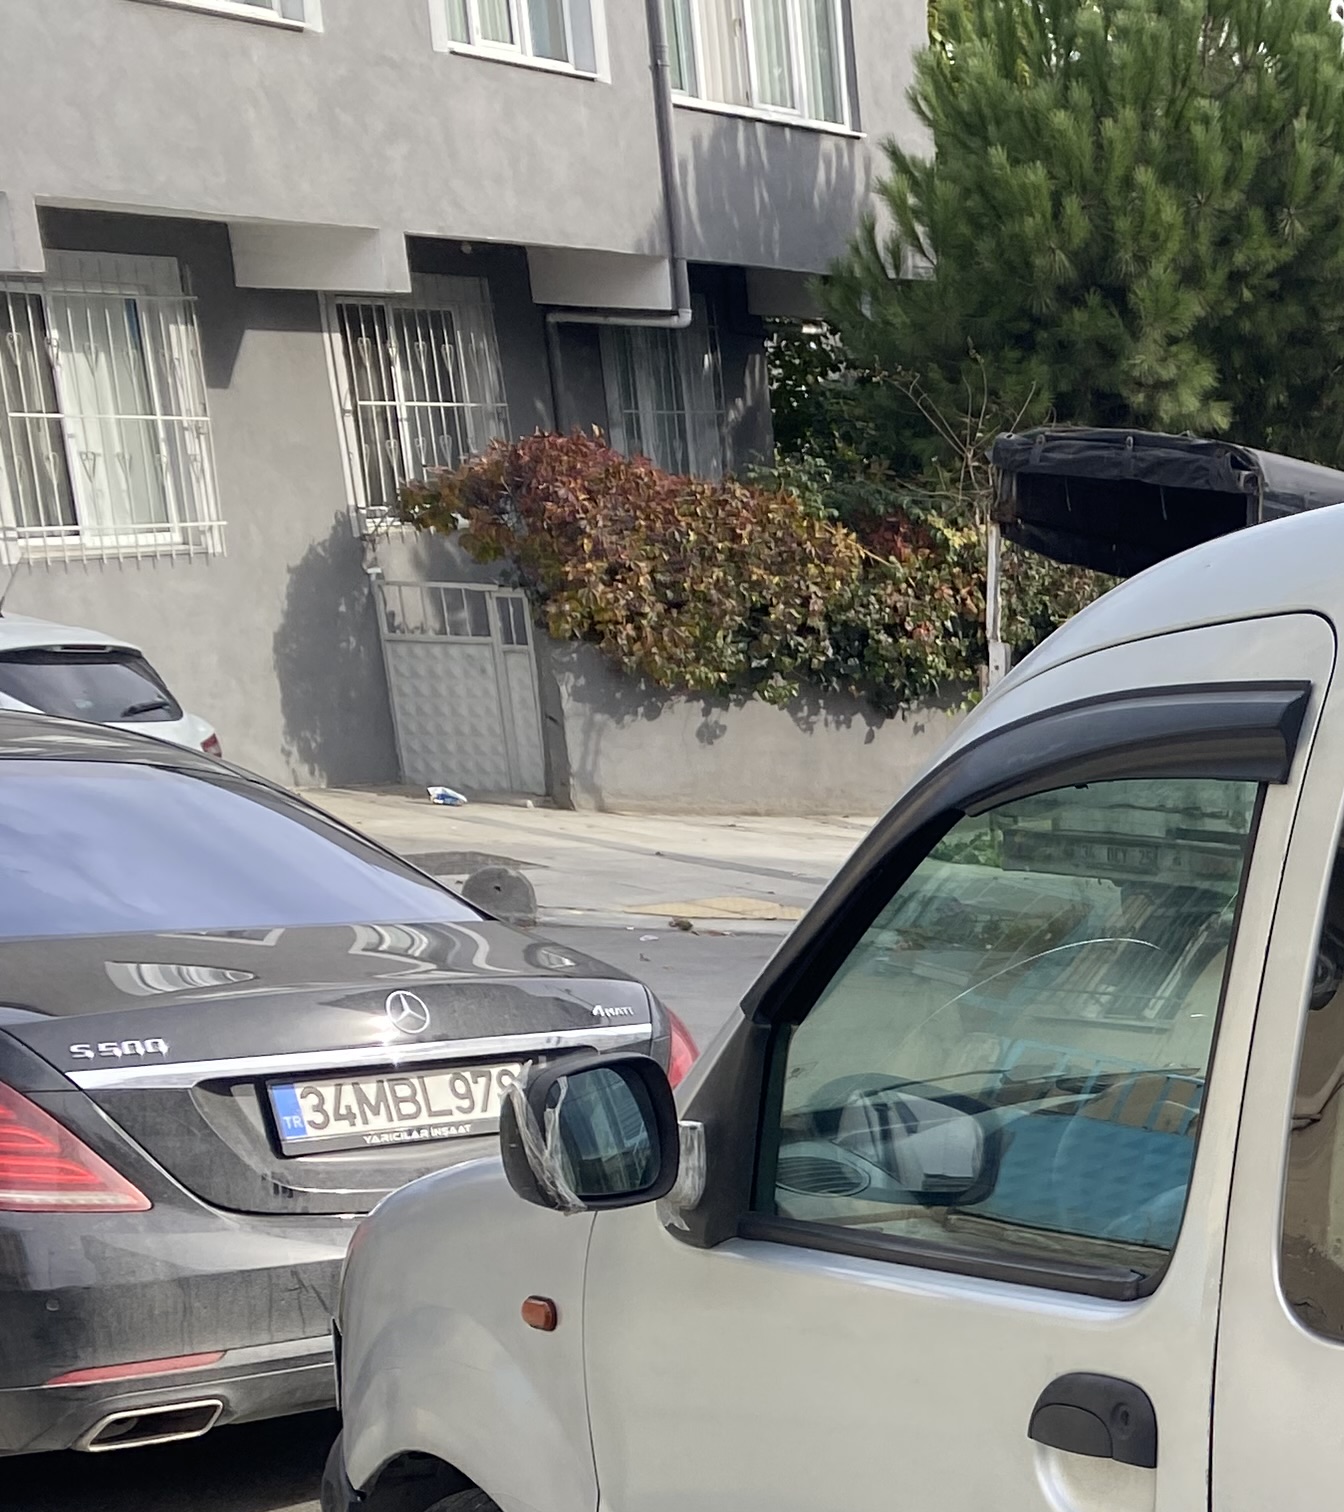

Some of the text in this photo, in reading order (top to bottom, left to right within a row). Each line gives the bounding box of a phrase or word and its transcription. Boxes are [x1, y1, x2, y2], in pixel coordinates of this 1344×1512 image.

[69, 1037, 170, 1061] S 500
[283, 1114, 303, 1130] TR
[363, 1128, 429, 1145] YARICILAR
